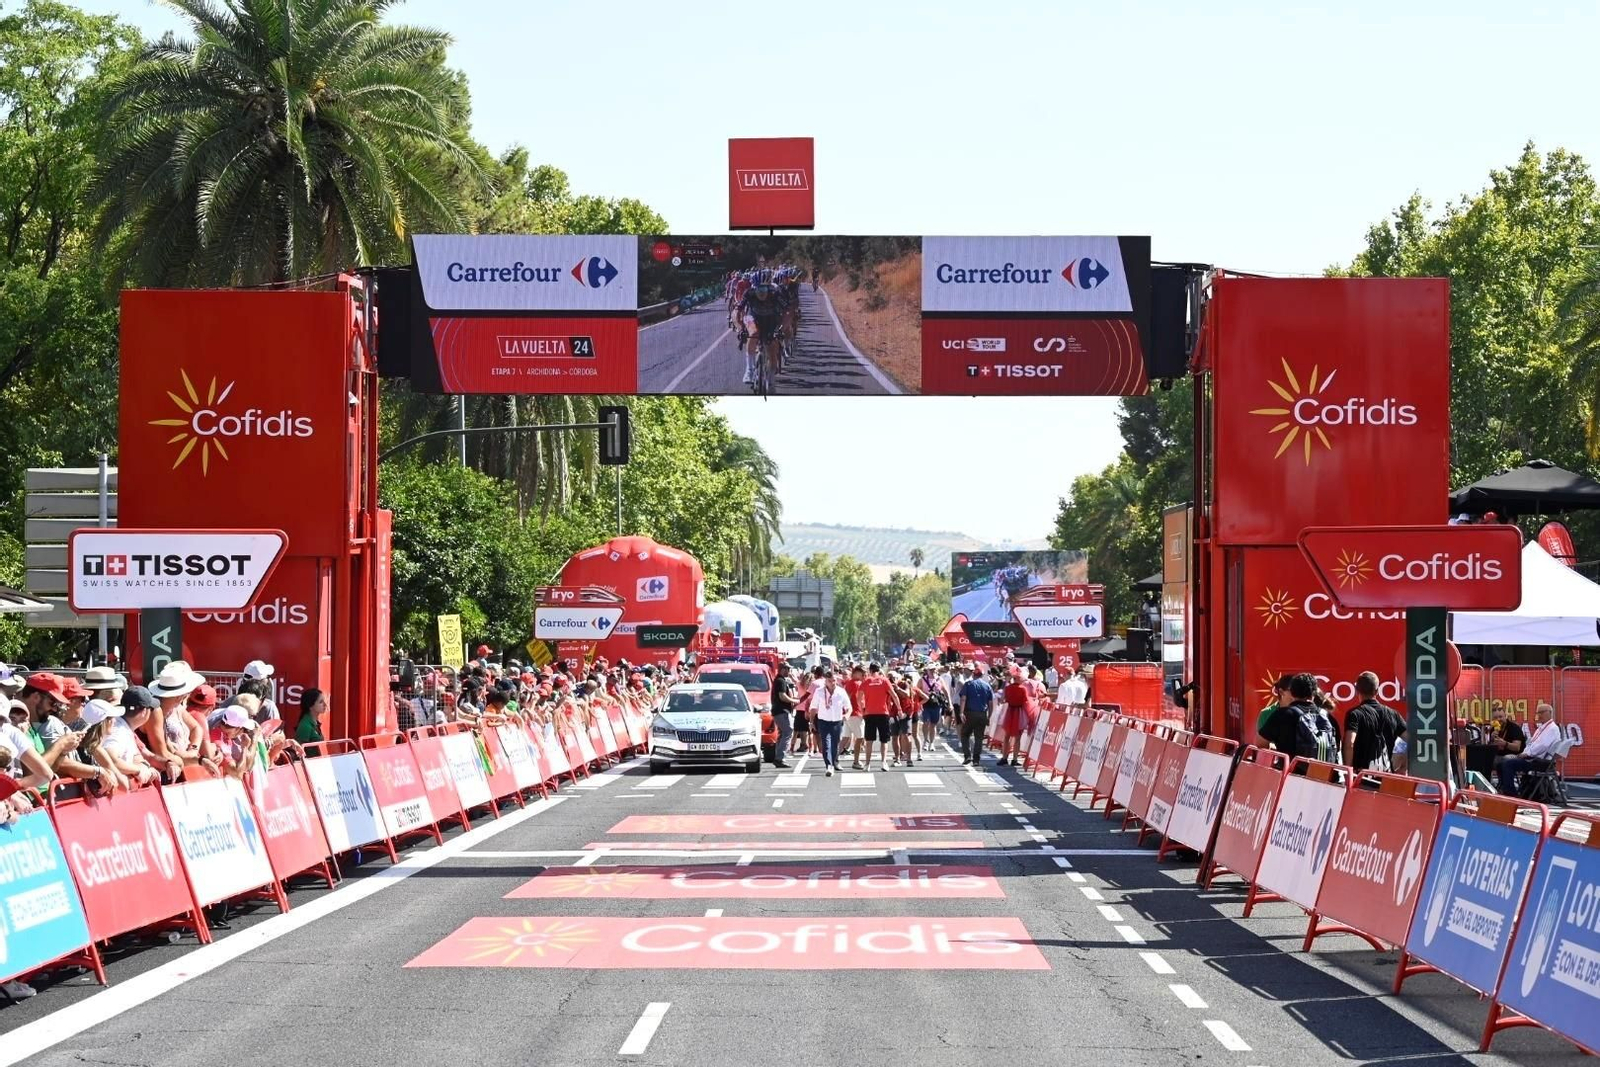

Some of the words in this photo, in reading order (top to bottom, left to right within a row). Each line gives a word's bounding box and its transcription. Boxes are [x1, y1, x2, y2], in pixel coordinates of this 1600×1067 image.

[744, 173, 758, 187] LA
[759, 172, 802, 187] VUELTA
[447, 261, 562, 283] Carrefour
[936, 262, 1052, 284] Carrefour
[505, 340, 520, 354] LA
[521, 340, 566, 354] VUELTA
[574, 340, 589, 354] 24
[942, 340, 965, 349] UCI
[491, 367, 511, 376] ETAPA
[994, 365, 1063, 377] TISSOT
[191, 408, 314, 437] Cofidis
[1293, 397, 1419, 427] Cofidis
[131, 554, 252, 576] TISSOT
[1378, 552, 1502, 581] Cofidis
[82, 579, 119, 587] SWISS
[125, 579, 180, 587] WATCHES
[185, 579, 220, 587] SINCE
[1061, 586, 1085, 600] iryo
[551, 588, 575, 602] iryo
[539, 617, 588, 629] Carrefour
[1024, 616, 1074, 628] Carrefour
[444, 646, 460, 657] STOP
[992, 657, 1003, 666] 50
[1058, 656, 1073, 667] 25
[318, 781, 358, 817] Carrefour
[723, 815, 958, 828] Cofidis
[1223, 789, 1257, 835] Carrefour
[178, 813, 237, 861] Carrefour
[1269, 807, 1313, 857] Carrefour
[70, 830, 149, 888] Carrefour
[1331, 826, 1393, 885] Carrefour
[671, 869, 988, 890] Cofidis
[1459, 846, 1519, 900] LOTERÍAS
[1452, 906, 1466, 927] CON
[1464, 911, 1474, 930] EL
[1470, 913, 1500, 941] DEPORTE
[621, 923, 1022, 954] Cofidis
[1558, 950, 1577, 975] CON
[1575, 956, 1586, 979] EL
